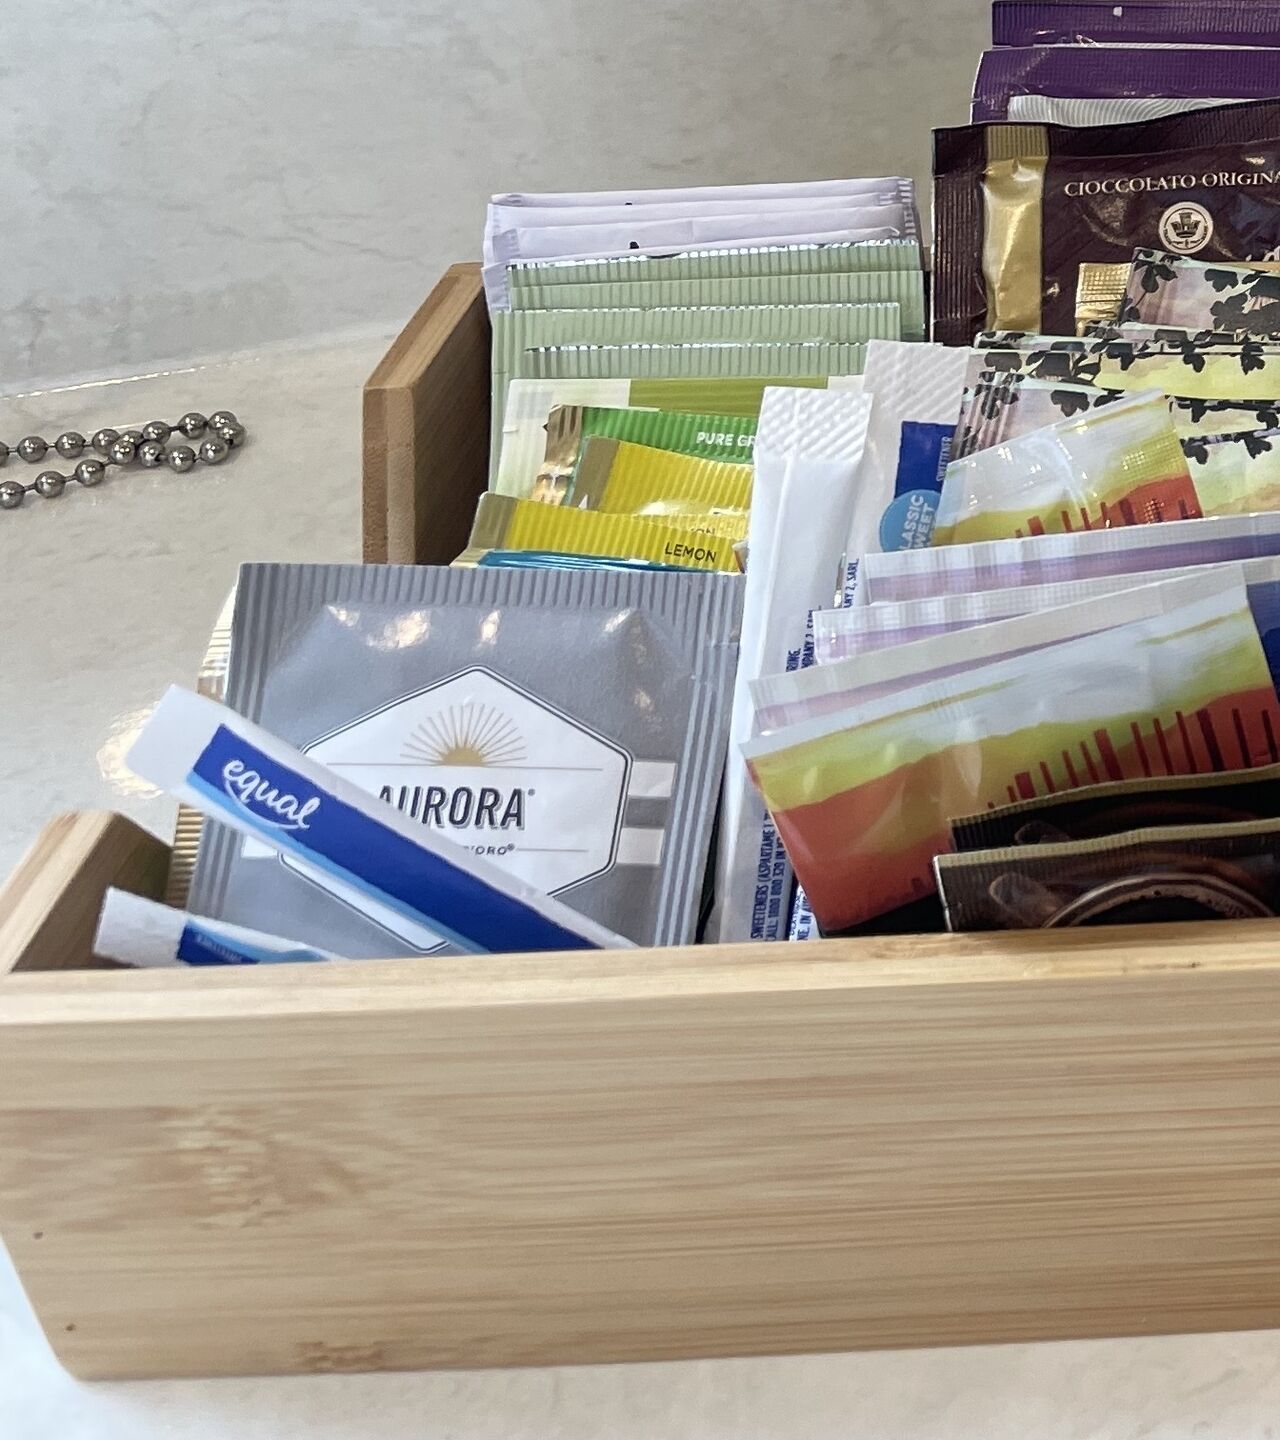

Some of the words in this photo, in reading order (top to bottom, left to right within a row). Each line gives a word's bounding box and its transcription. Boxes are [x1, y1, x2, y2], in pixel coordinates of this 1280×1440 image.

[1064, 174, 1196, 198] CIOCCOLATO
[696, 431, 734, 447] PURE
[900, 494, 925, 549] LASSIC
[914, 503, 935, 549] WEET
[665, 541, 717, 564] LEMON
[223, 759, 322, 830] equal
